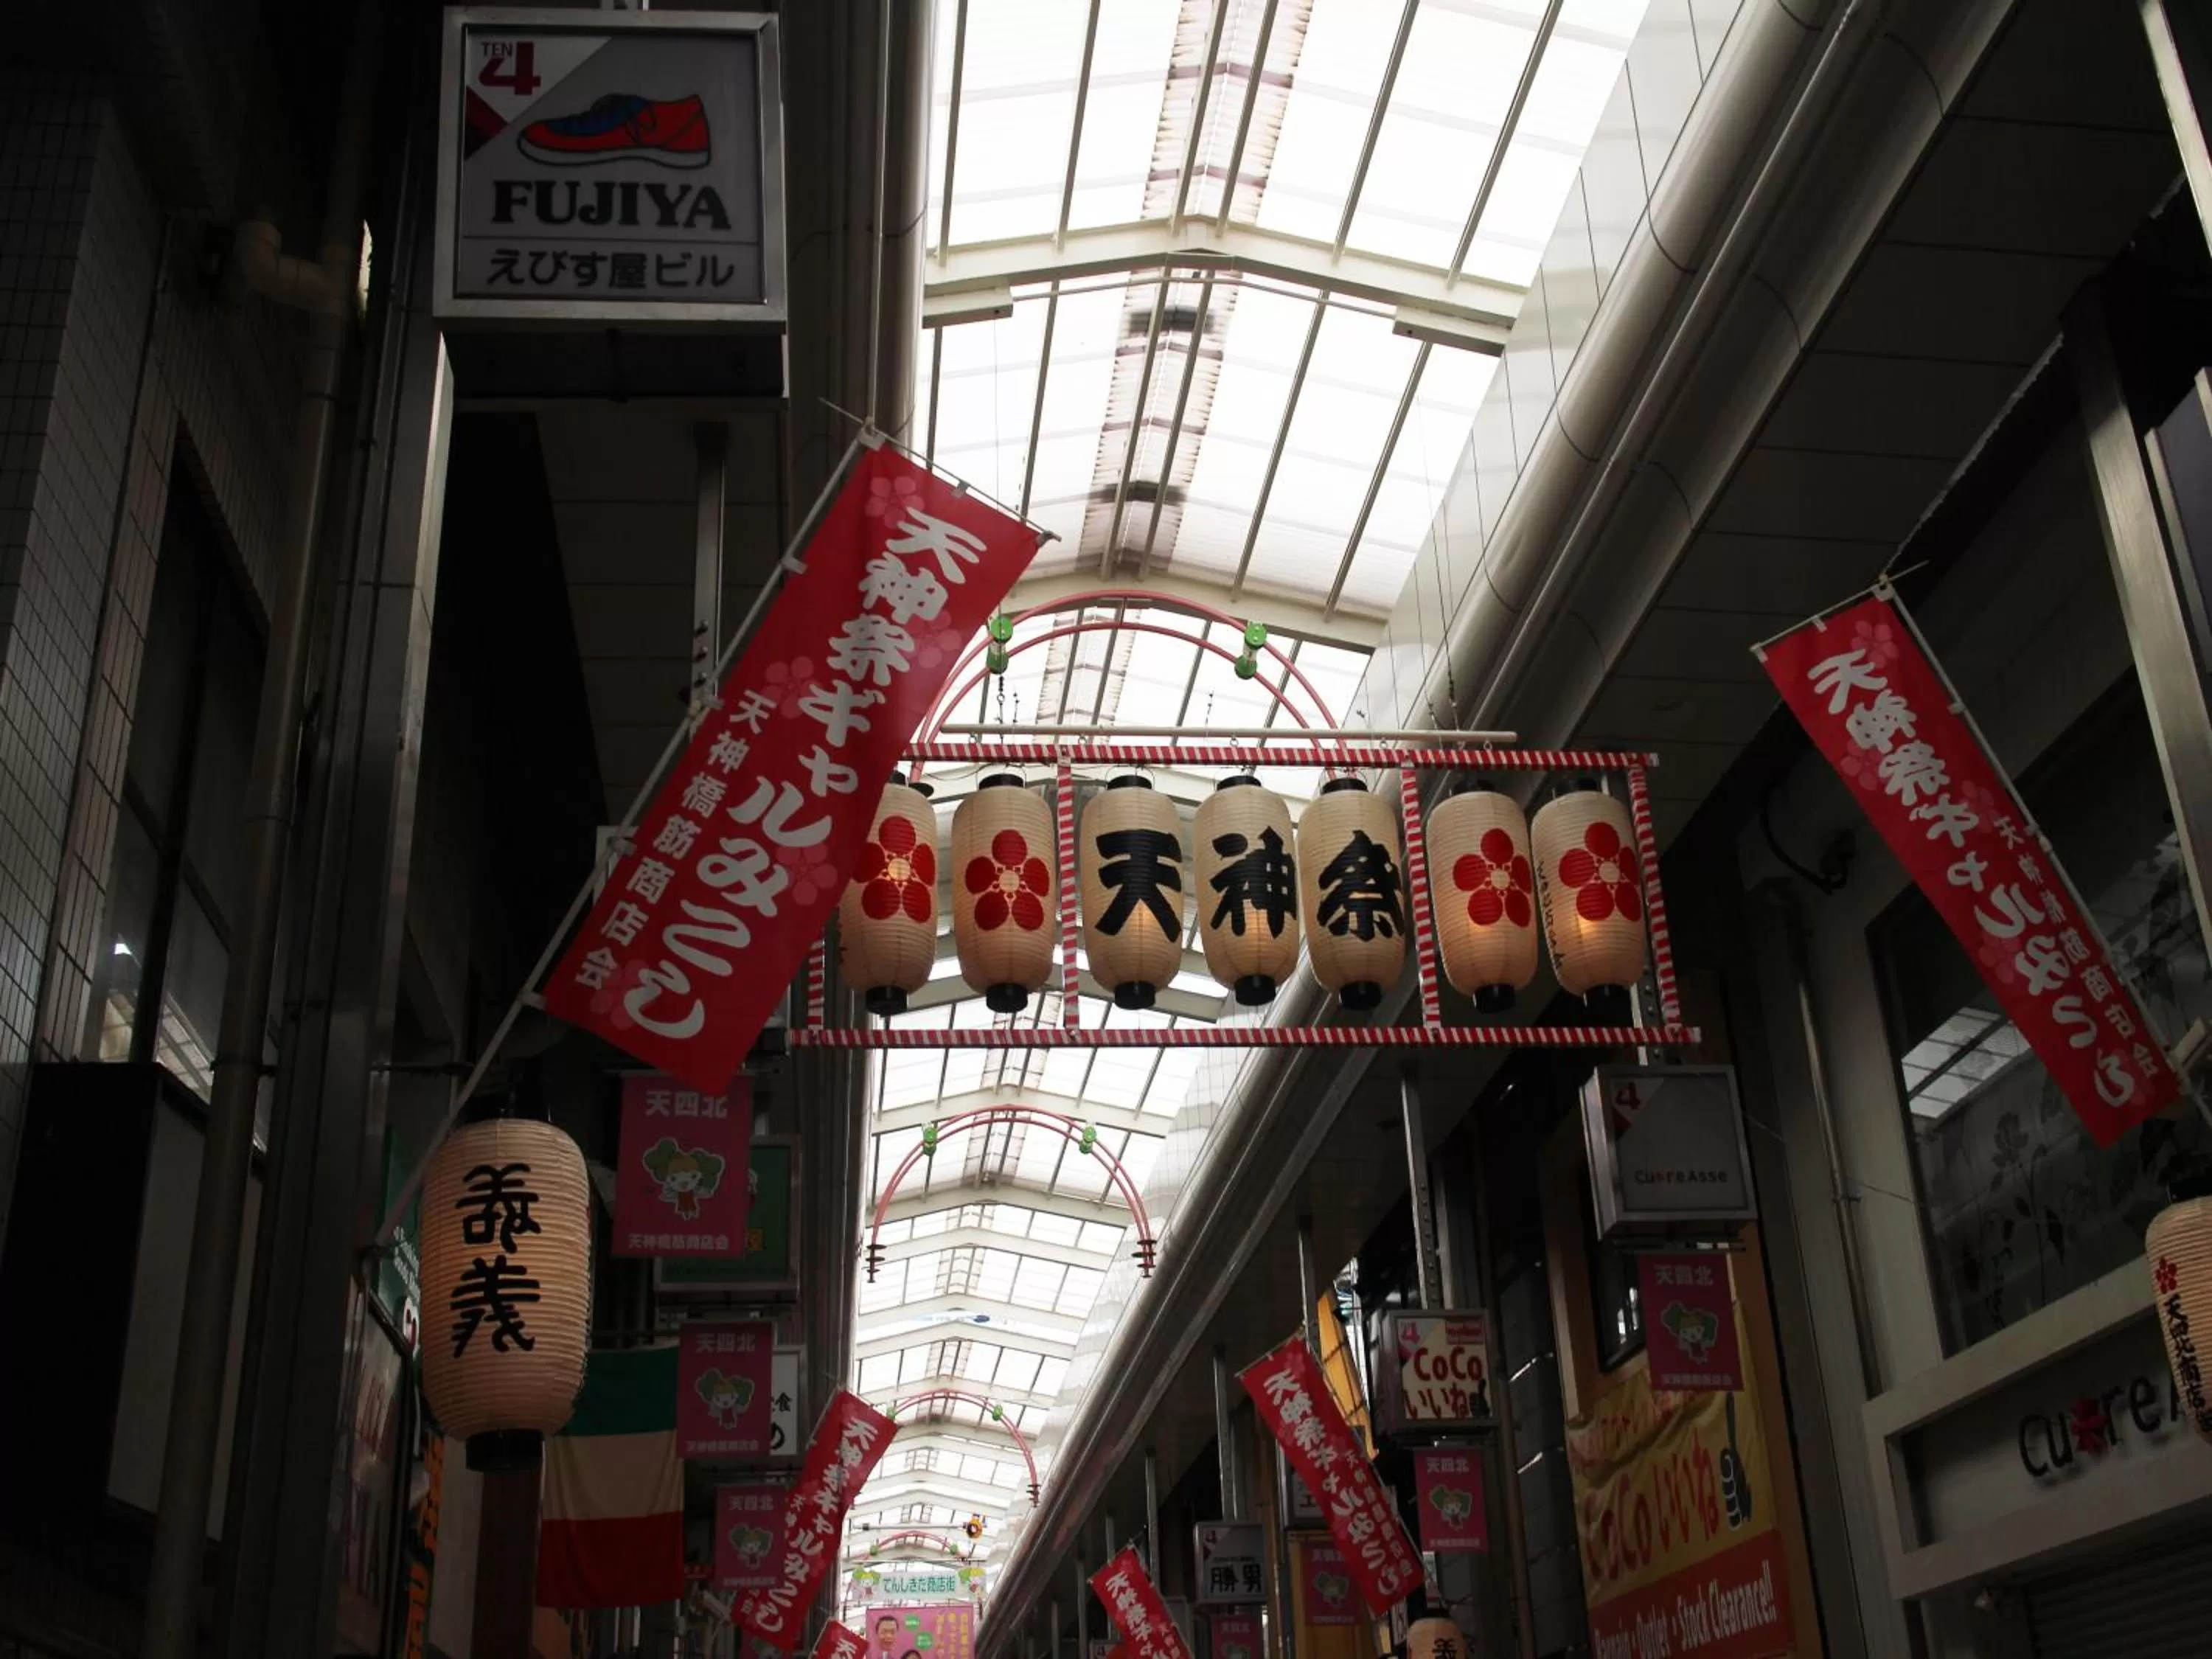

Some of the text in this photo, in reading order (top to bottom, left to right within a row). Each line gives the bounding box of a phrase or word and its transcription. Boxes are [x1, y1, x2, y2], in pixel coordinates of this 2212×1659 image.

[479, 42, 541, 94] TEN 4
[491, 180, 731, 229] FUJIYA
[487, 248, 734, 288] えびす屋ビル
[574, 689, 776, 993] 天神橋筋商店会
[1094, 825, 1405, 942] 天神祭
[645, 1090, 728, 1119] 天四北
[695, 1333, 756, 1353] 天四北
[1414, 1346, 1481, 1381] CoCo
[1403, 1382, 1470, 1420] いいね
[883, 1574, 956, 1593] てんしきた商店街
